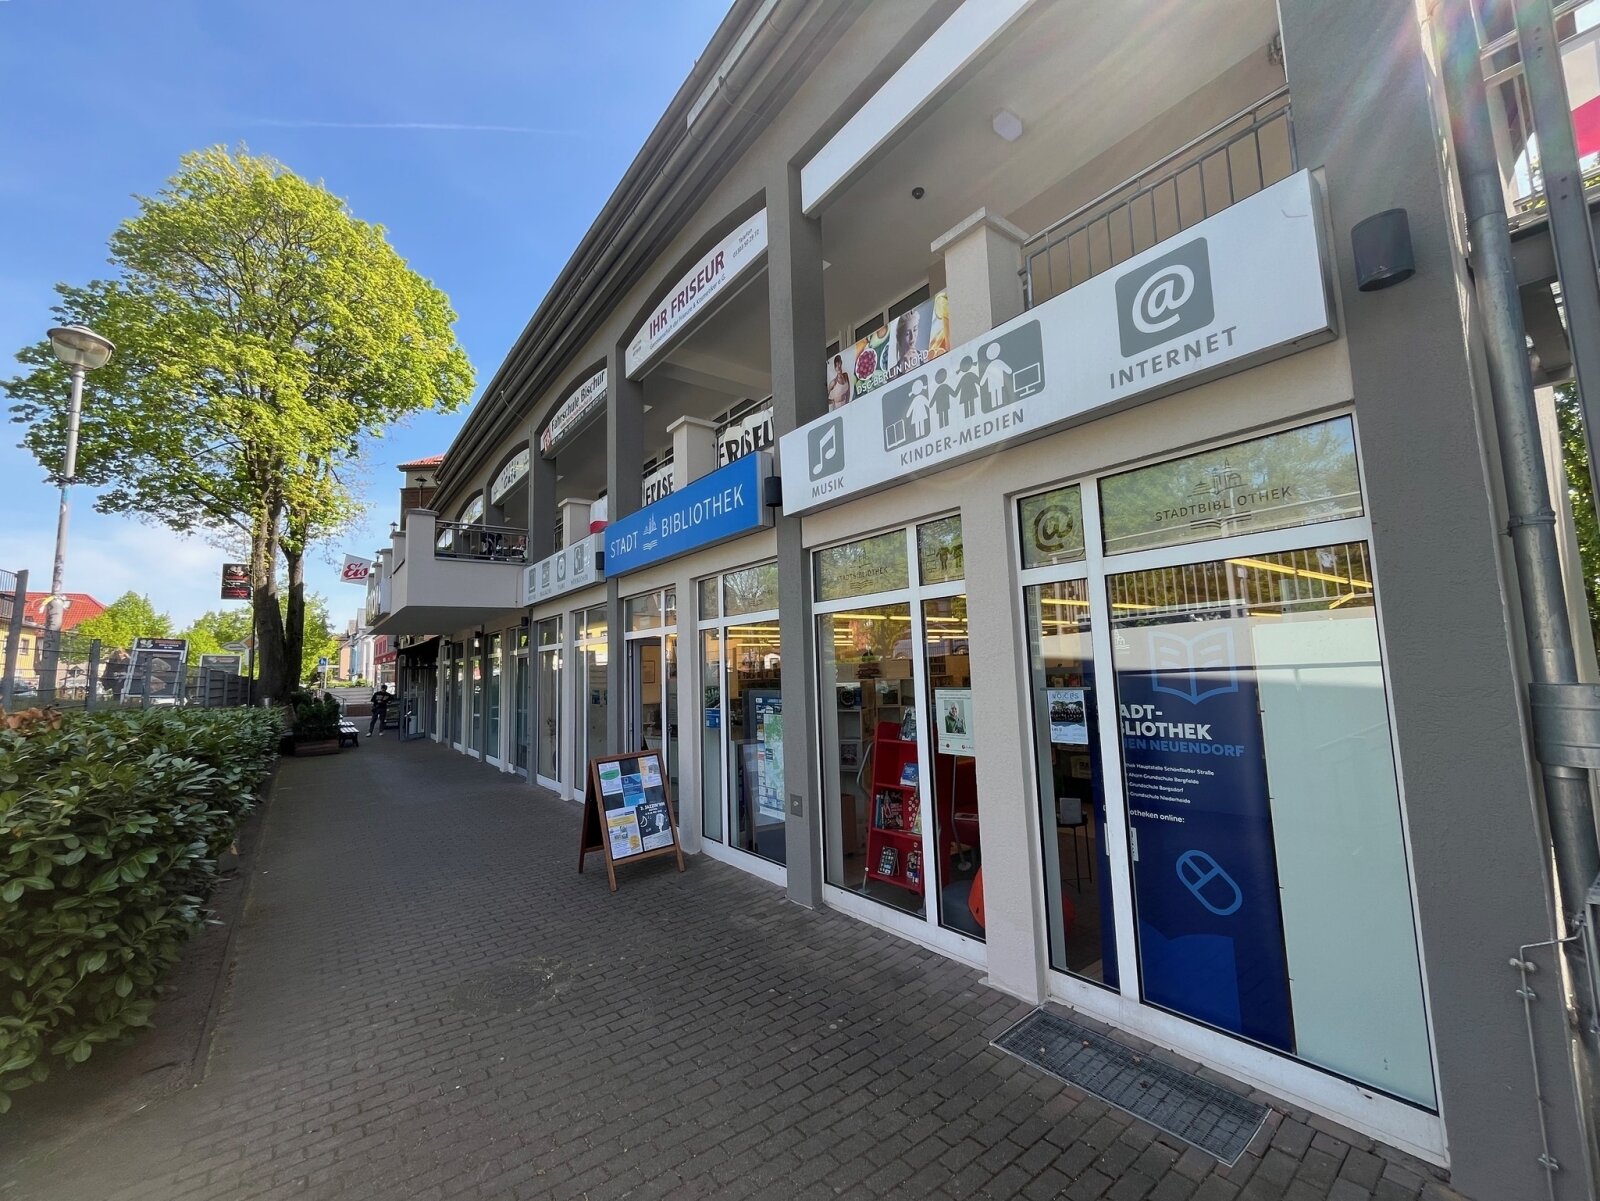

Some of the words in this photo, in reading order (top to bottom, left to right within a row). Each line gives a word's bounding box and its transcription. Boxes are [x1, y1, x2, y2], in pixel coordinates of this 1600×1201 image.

[649, 308, 669, 341] IHR
[670, 250, 725, 318] FRISEUR
[903, 349, 930, 371] NORD
[1109, 325, 1238, 390] INTERNET
[900, 407, 1026, 467] KINDER-MEDIEN
[811, 476, 845, 498] MUSIK
[1154, 486, 1293, 523] STADTBIBLOTHEK
[610, 530, 639, 559] STADT
[661, 483, 745, 538] BIBLIOTHEK
[343, 562, 369, 580] Eis
[1150, 739, 1245, 757] NEUENDORF
[1136, 763, 1164, 772] Hauptstelle
[1129, 781, 1159, 790] Grundschule
[1143, 774, 1174, 782] Grundschule
[1129, 791, 1160, 800] Grundschule
[1159, 814, 1185, 824] online:
